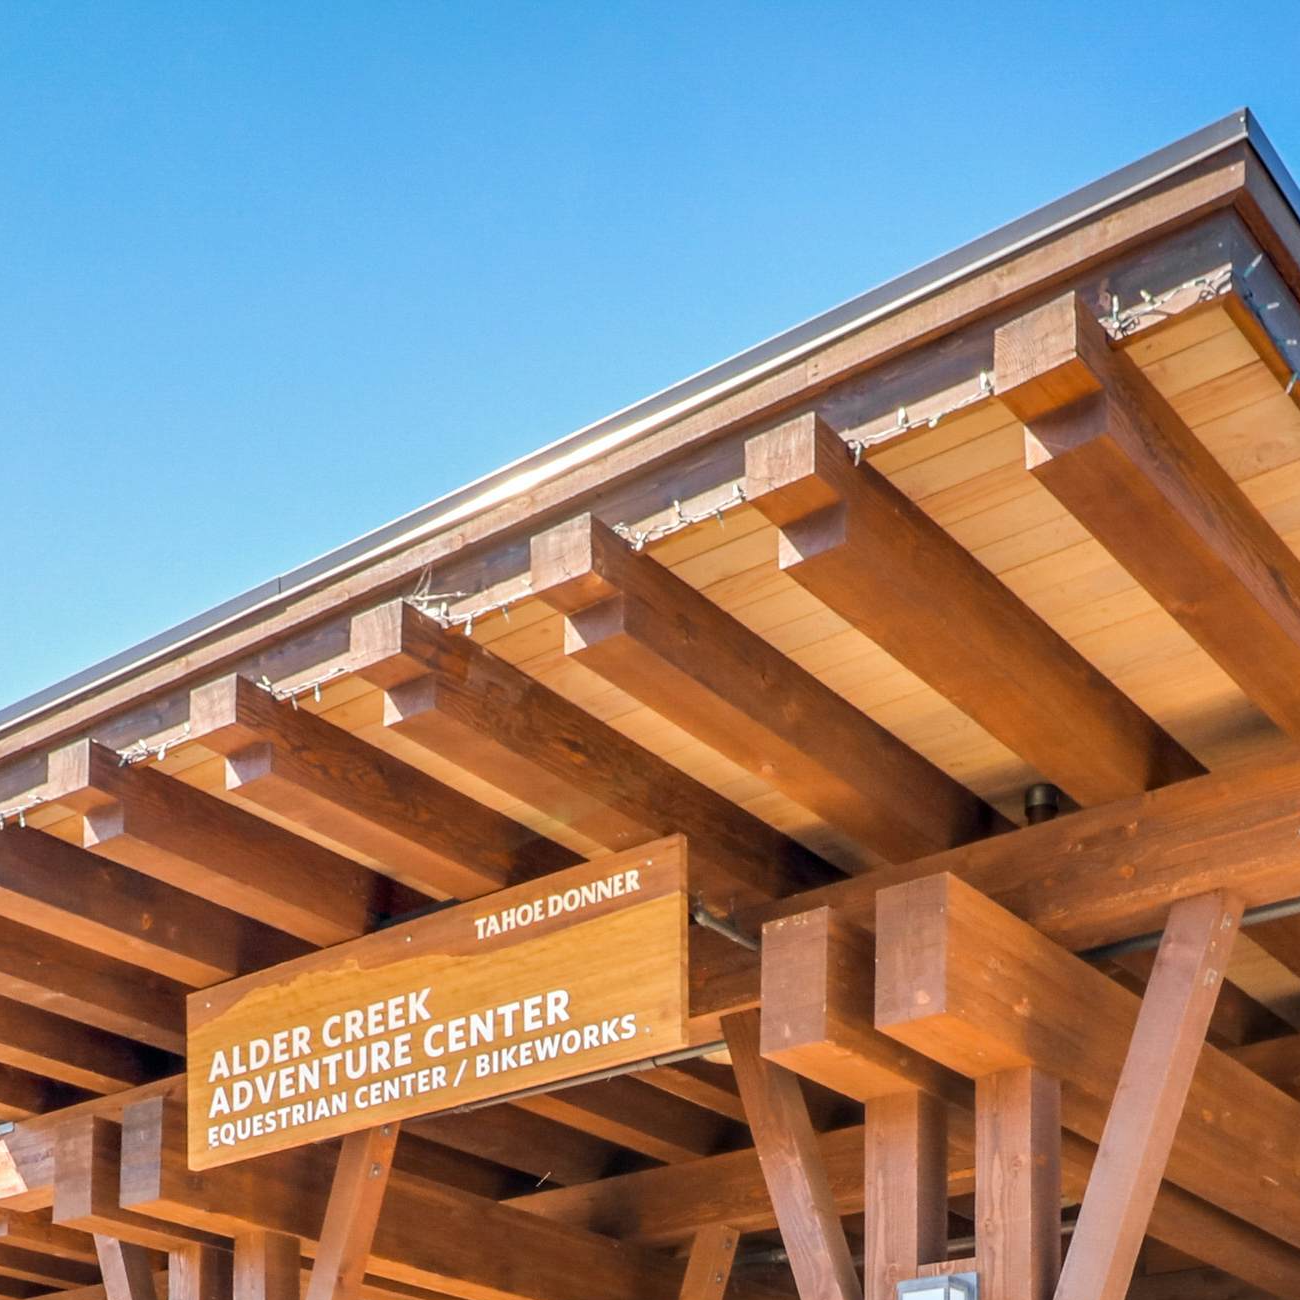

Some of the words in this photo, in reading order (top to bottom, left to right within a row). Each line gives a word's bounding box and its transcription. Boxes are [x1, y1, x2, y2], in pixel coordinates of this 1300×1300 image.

[474, 899, 546, 940] TAHOE
[547, 869, 641, 918] DONNER
[207, 1091, 348, 1148] EQUESTRIAN
[354, 1065, 448, 1110] CENTER
[452, 1058, 468, 1088] /
[475, 1013, 637, 1079] BIKEWORKS
[208, 1025, 312, 1083] ALDER
[321, 986, 432, 1048] CREEK
[208, 1032, 413, 1119] ADVENTURE
[423, 988, 571, 1058] CENTER
